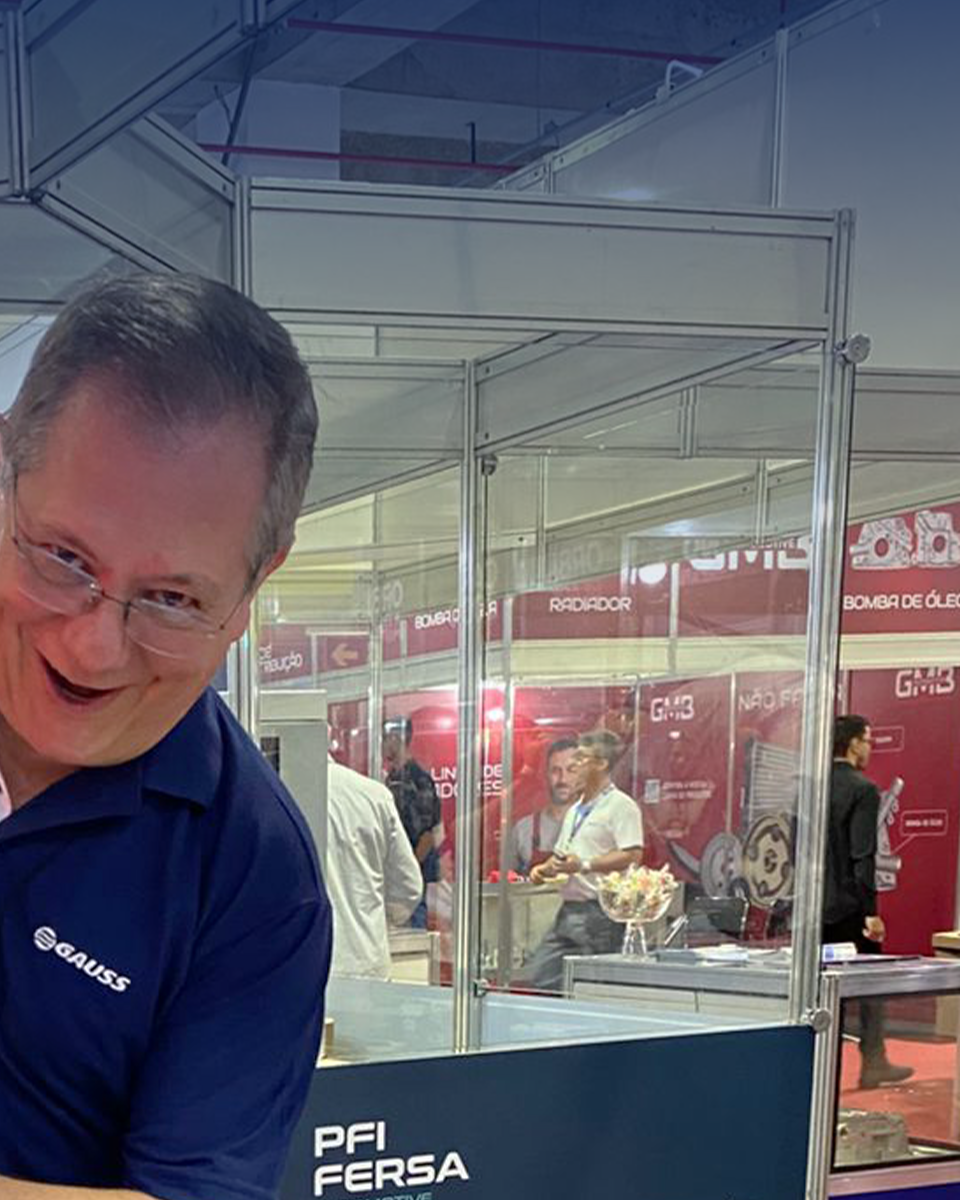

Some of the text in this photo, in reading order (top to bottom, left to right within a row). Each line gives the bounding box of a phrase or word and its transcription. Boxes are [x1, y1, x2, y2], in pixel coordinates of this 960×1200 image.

[550, 597, 632, 612] RADIADOR
[843, 594, 899, 611] BOMBA
[902, 593, 923, 609] DE
[895, 666, 955, 698] GMB
[651, 695, 694, 722] GMB
[739, 685, 777, 712] NÃO
[53, 941, 132, 993] GAUSS
[314, 1121, 385, 1157] PFI
[314, 1151, 469, 1197] FERSA
